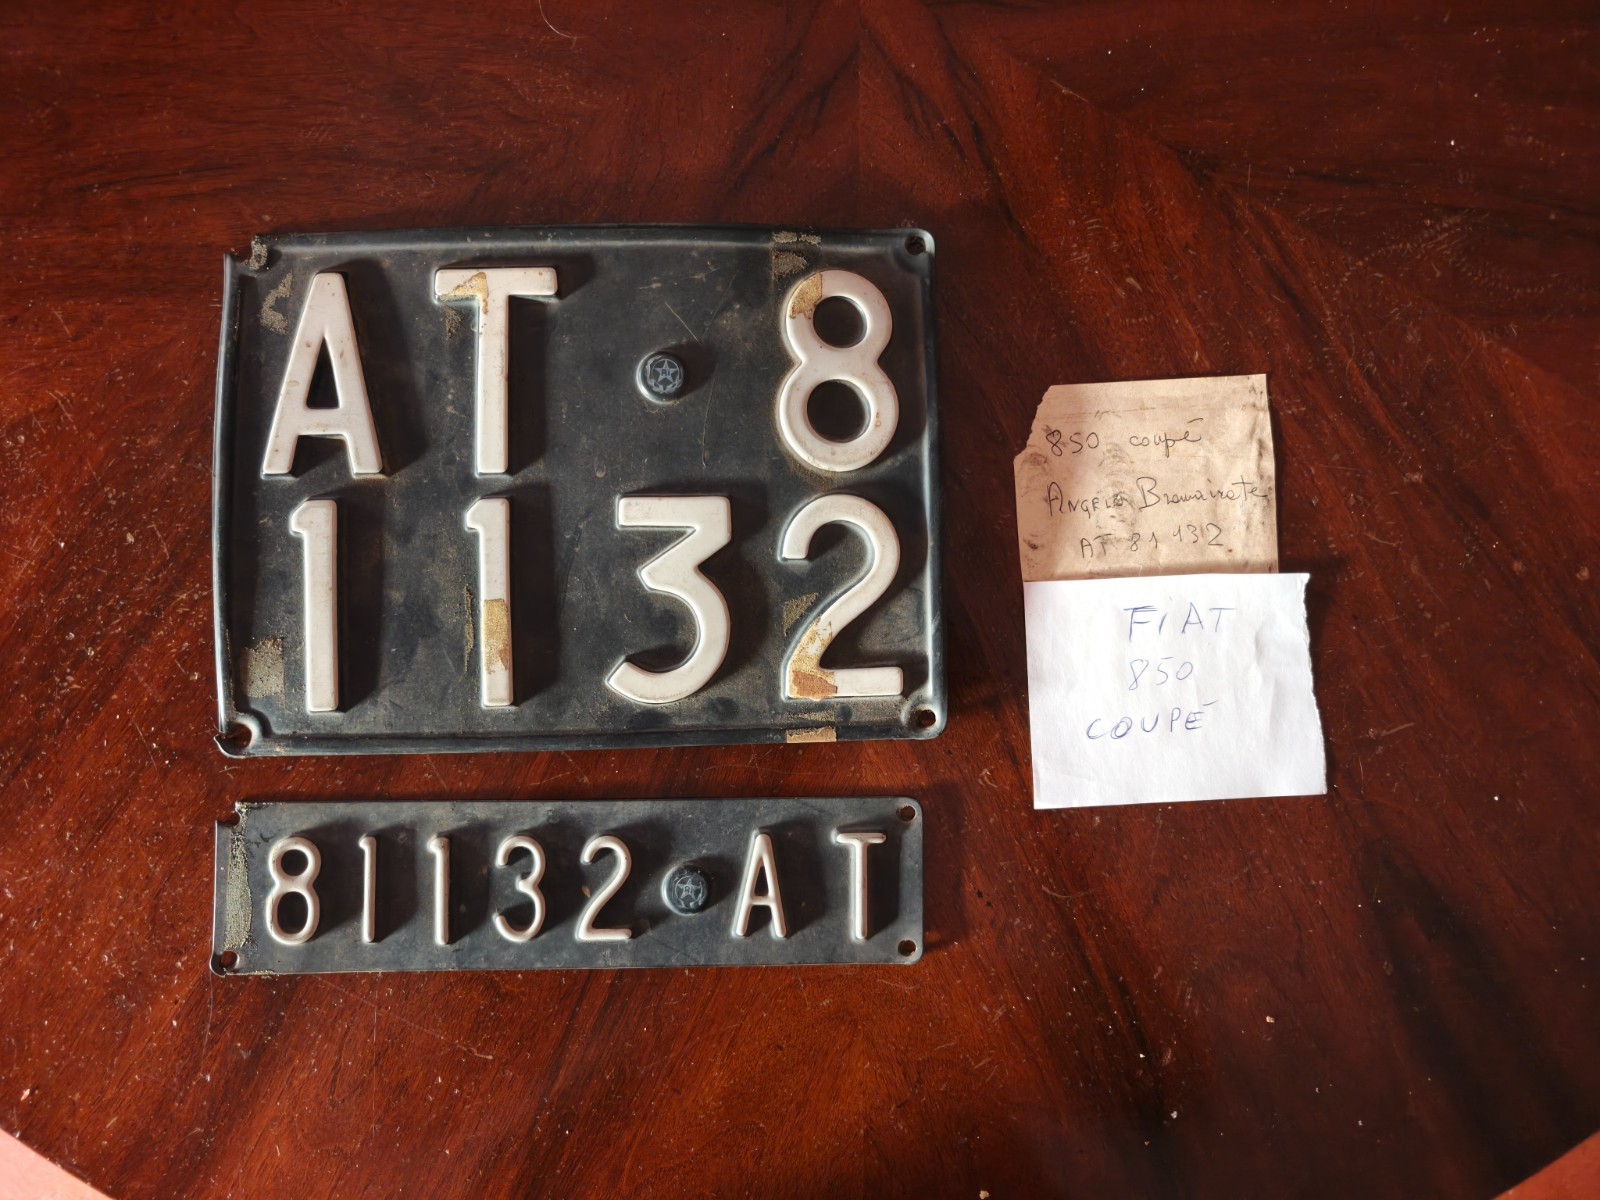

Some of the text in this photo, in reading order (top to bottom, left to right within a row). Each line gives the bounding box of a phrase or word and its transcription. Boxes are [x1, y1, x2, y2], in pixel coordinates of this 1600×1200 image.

[261, 266, 900, 477] AT 8
[1045, 429, 1100, 457] 850
[1080, 533, 1113, 559] AT
[288, 493, 904, 713] 1132
[1127, 656, 1194, 690] 850
[265, 829, 888, 946] 81132 AT
